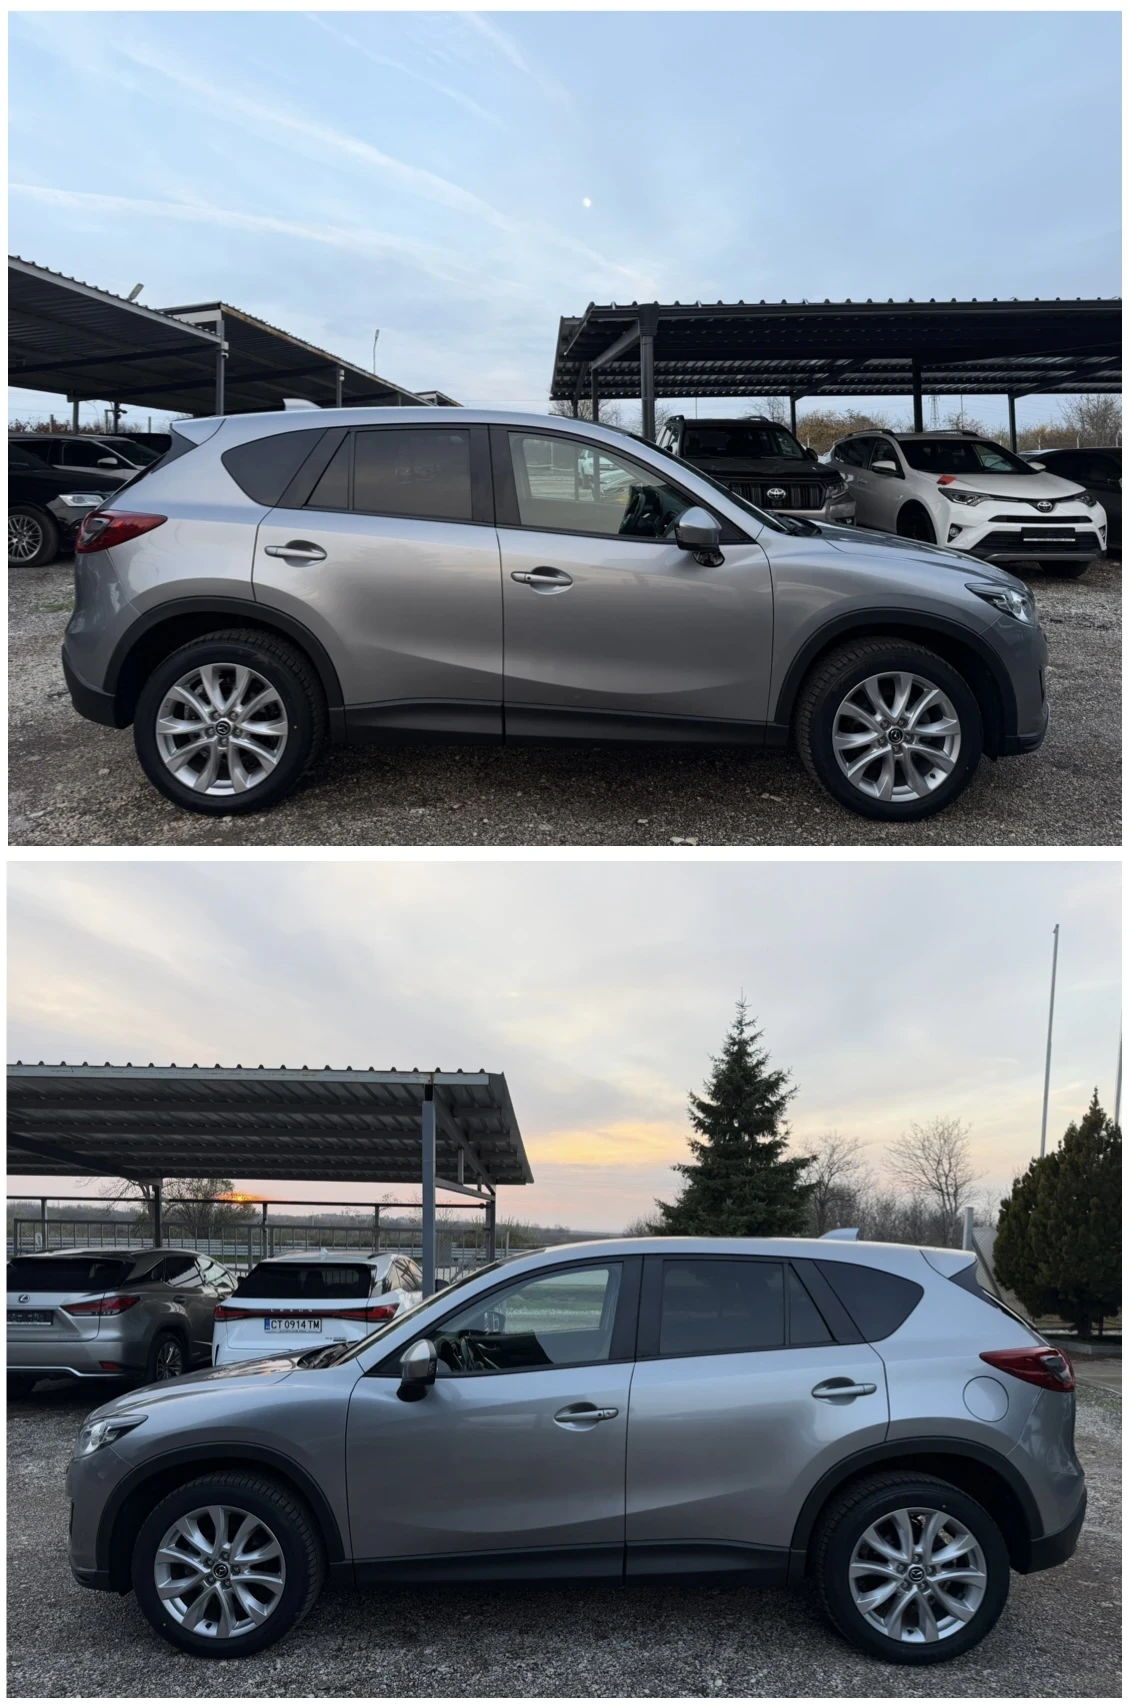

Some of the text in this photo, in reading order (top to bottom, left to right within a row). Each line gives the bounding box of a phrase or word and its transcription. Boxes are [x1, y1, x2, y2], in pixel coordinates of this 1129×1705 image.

[271, 1320, 320, 1329] CT 0914 TM
